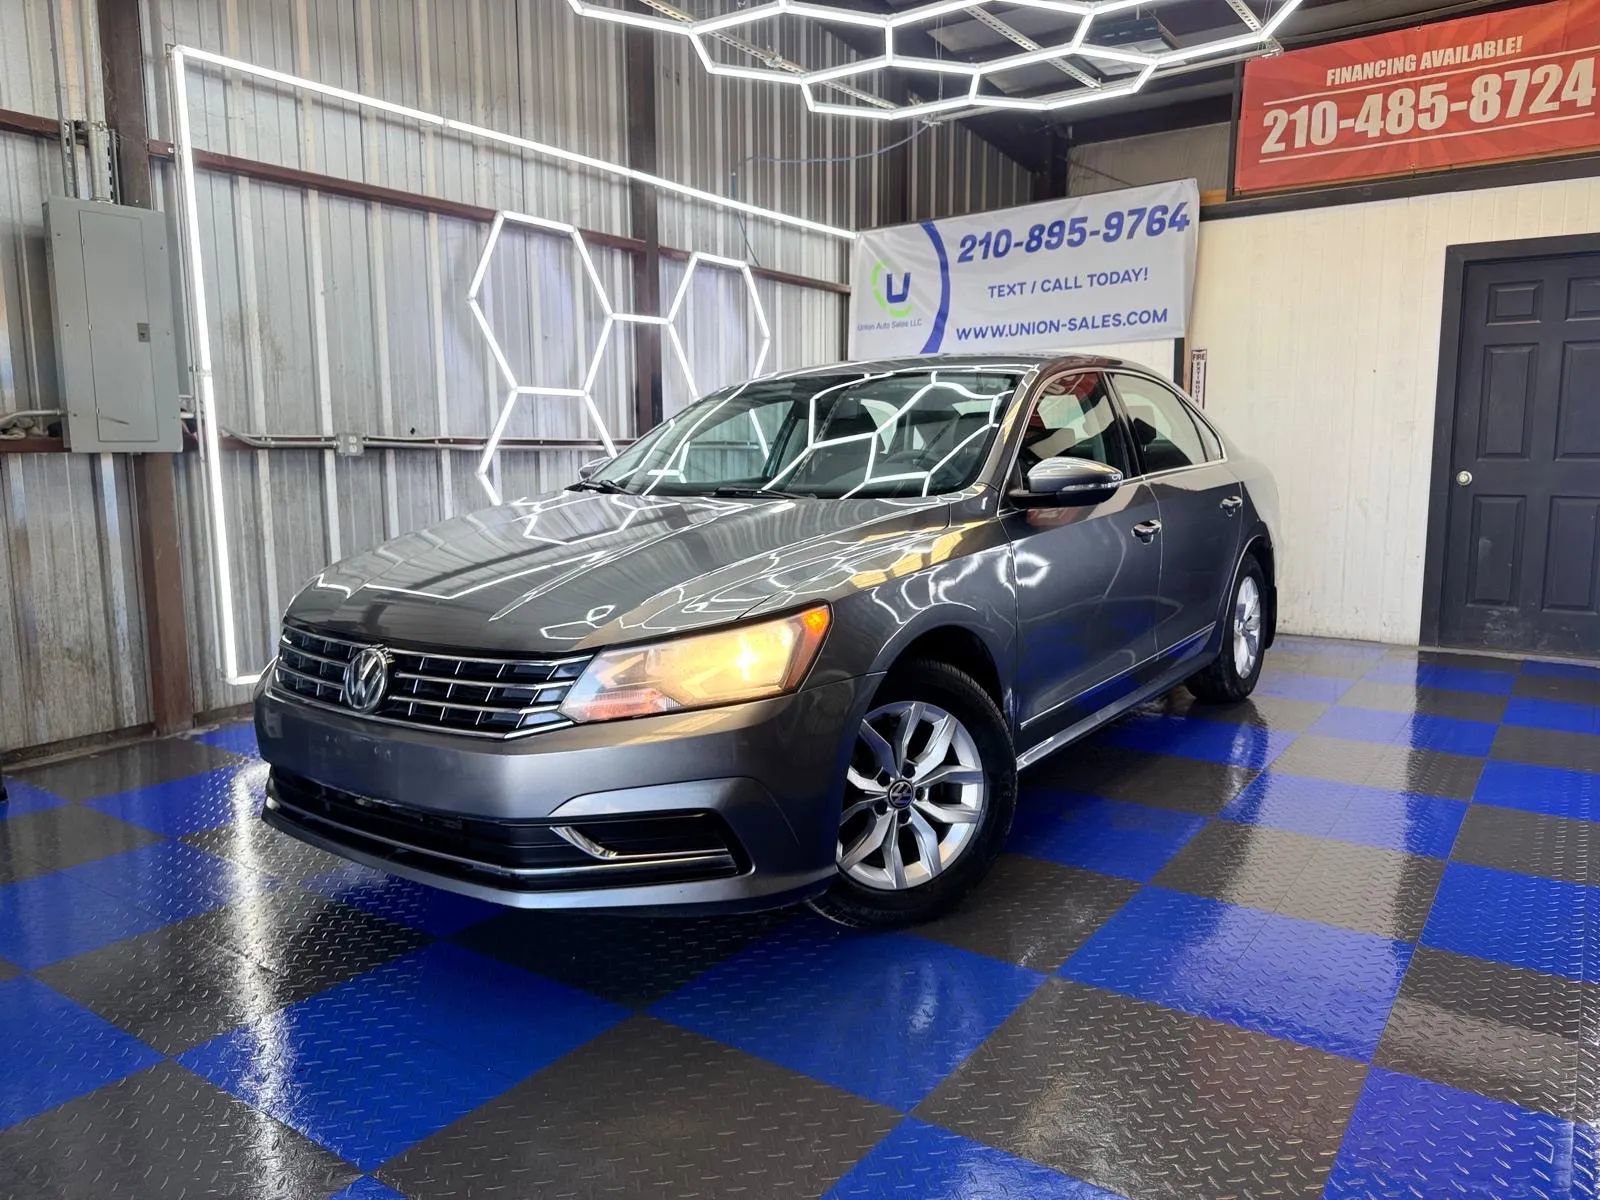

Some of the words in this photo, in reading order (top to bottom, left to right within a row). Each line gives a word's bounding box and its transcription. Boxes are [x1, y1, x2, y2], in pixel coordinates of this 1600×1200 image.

[1326, 55, 1417, 86] FINANCING
[1419, 35, 1523, 70] AVAILABLE!
[1261, 57, 1596, 154] 210-485-8724
[957, 201, 1190, 263] 210-895-9764
[886, 271, 911, 304] U
[988, 282, 1026, 299] TEXT
[1031, 281, 1037, 295] /
[1040, 276, 1082, 293] CALL
[1087, 267, 1149, 288] TODAY!
[910, 318, 923, 328] LLC
[956, 308, 1168, 341] WWW.UNION-SALES.COM
[1192, 353, 1206, 361] FIRE
